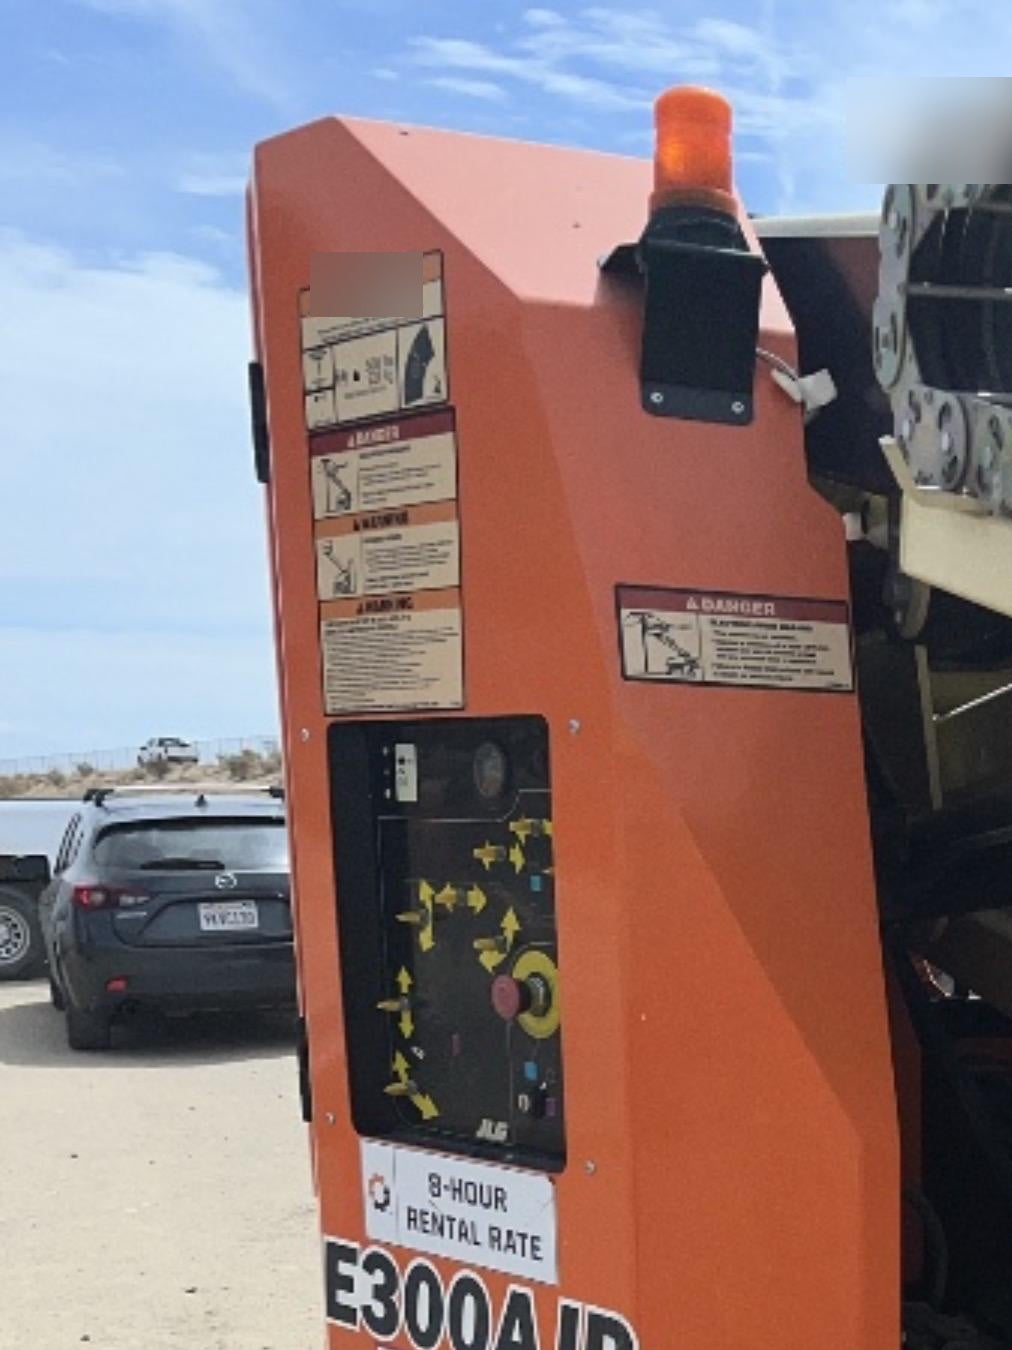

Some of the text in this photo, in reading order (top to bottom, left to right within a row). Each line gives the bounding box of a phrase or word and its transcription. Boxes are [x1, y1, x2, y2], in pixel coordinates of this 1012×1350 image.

[701, 598, 776, 616] DANGER
[475, 1118, 508, 1141] JLG
[428, 1172, 508, 1213] 8-HOUR
[407, 1206, 544, 1261] RENTAL RATE
